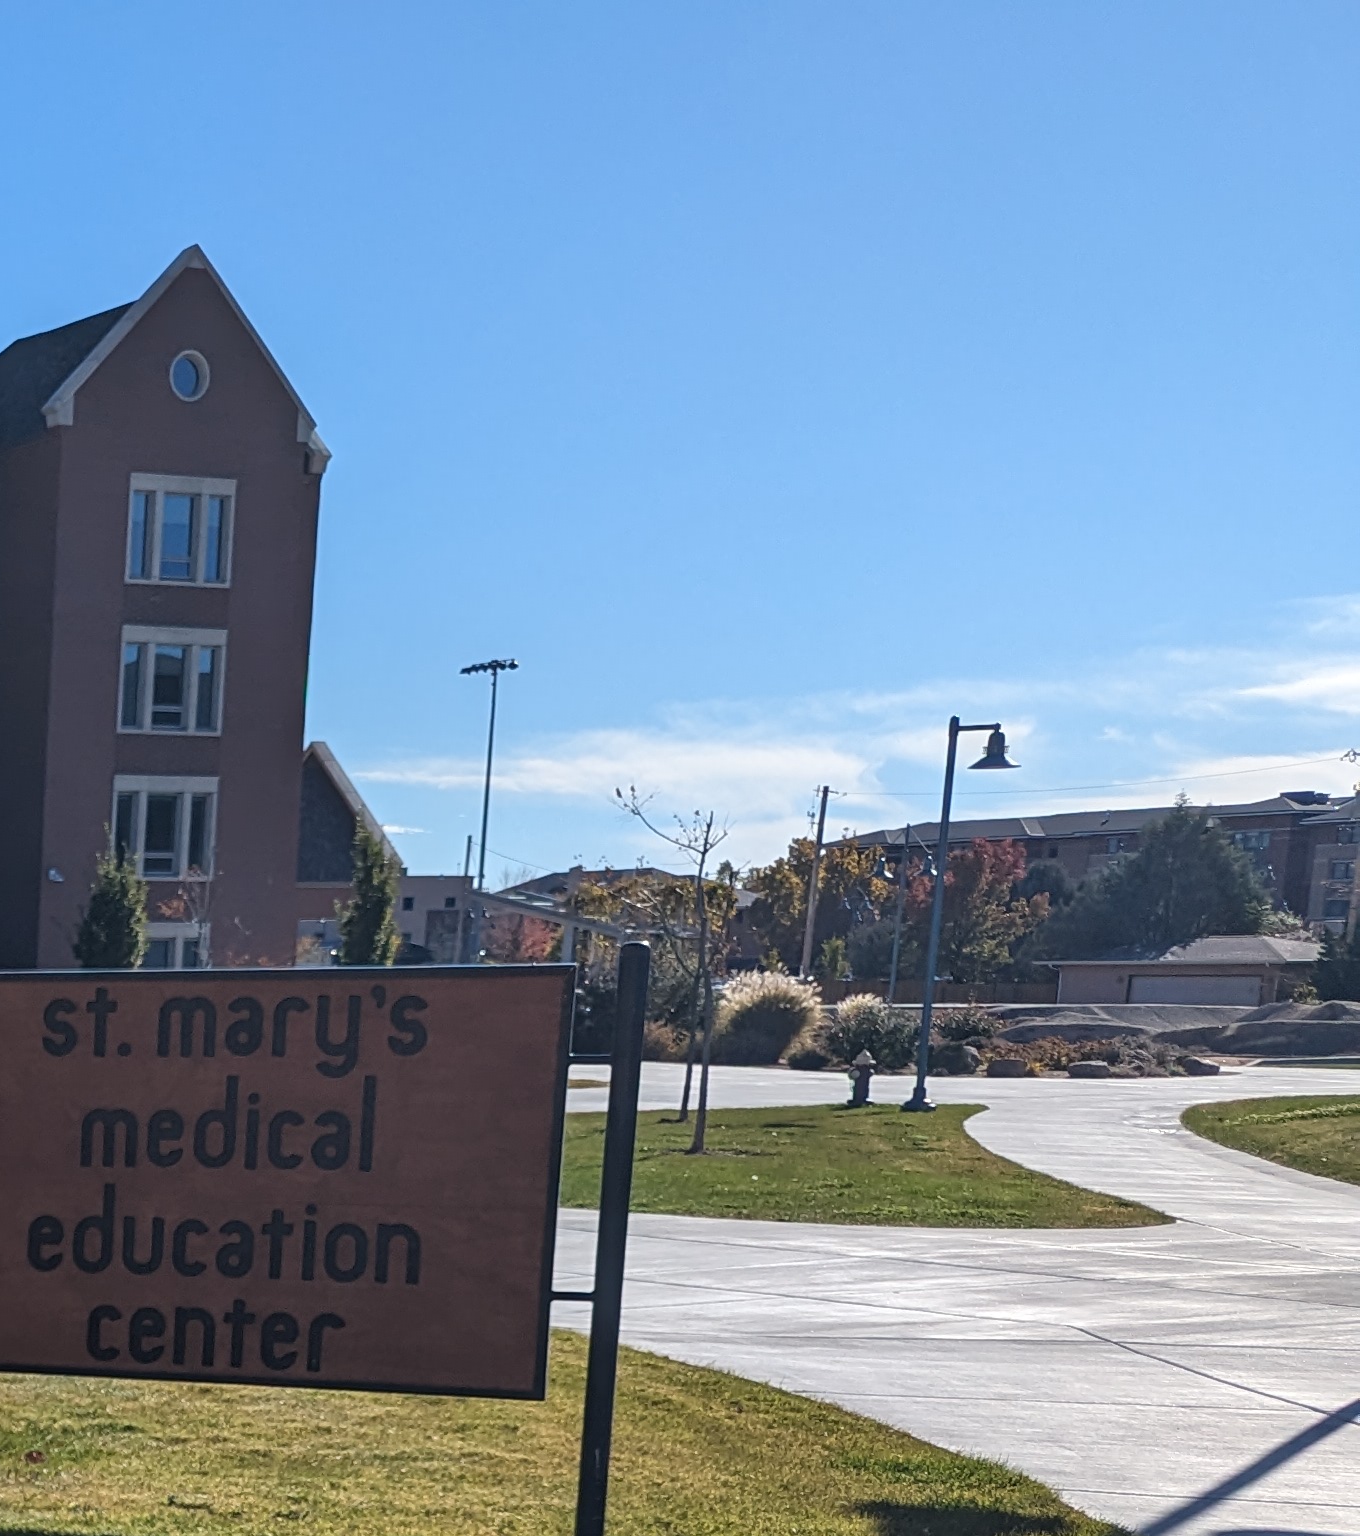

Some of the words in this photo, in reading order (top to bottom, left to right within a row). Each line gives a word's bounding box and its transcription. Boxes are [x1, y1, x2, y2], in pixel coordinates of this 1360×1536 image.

[41, 986, 132, 1059] st.
[156, 984, 429, 1079] mary's
[80, 1074, 377, 1172] medical
[27, 1182, 422, 1286] education
[86, 1298, 346, 1373] center
